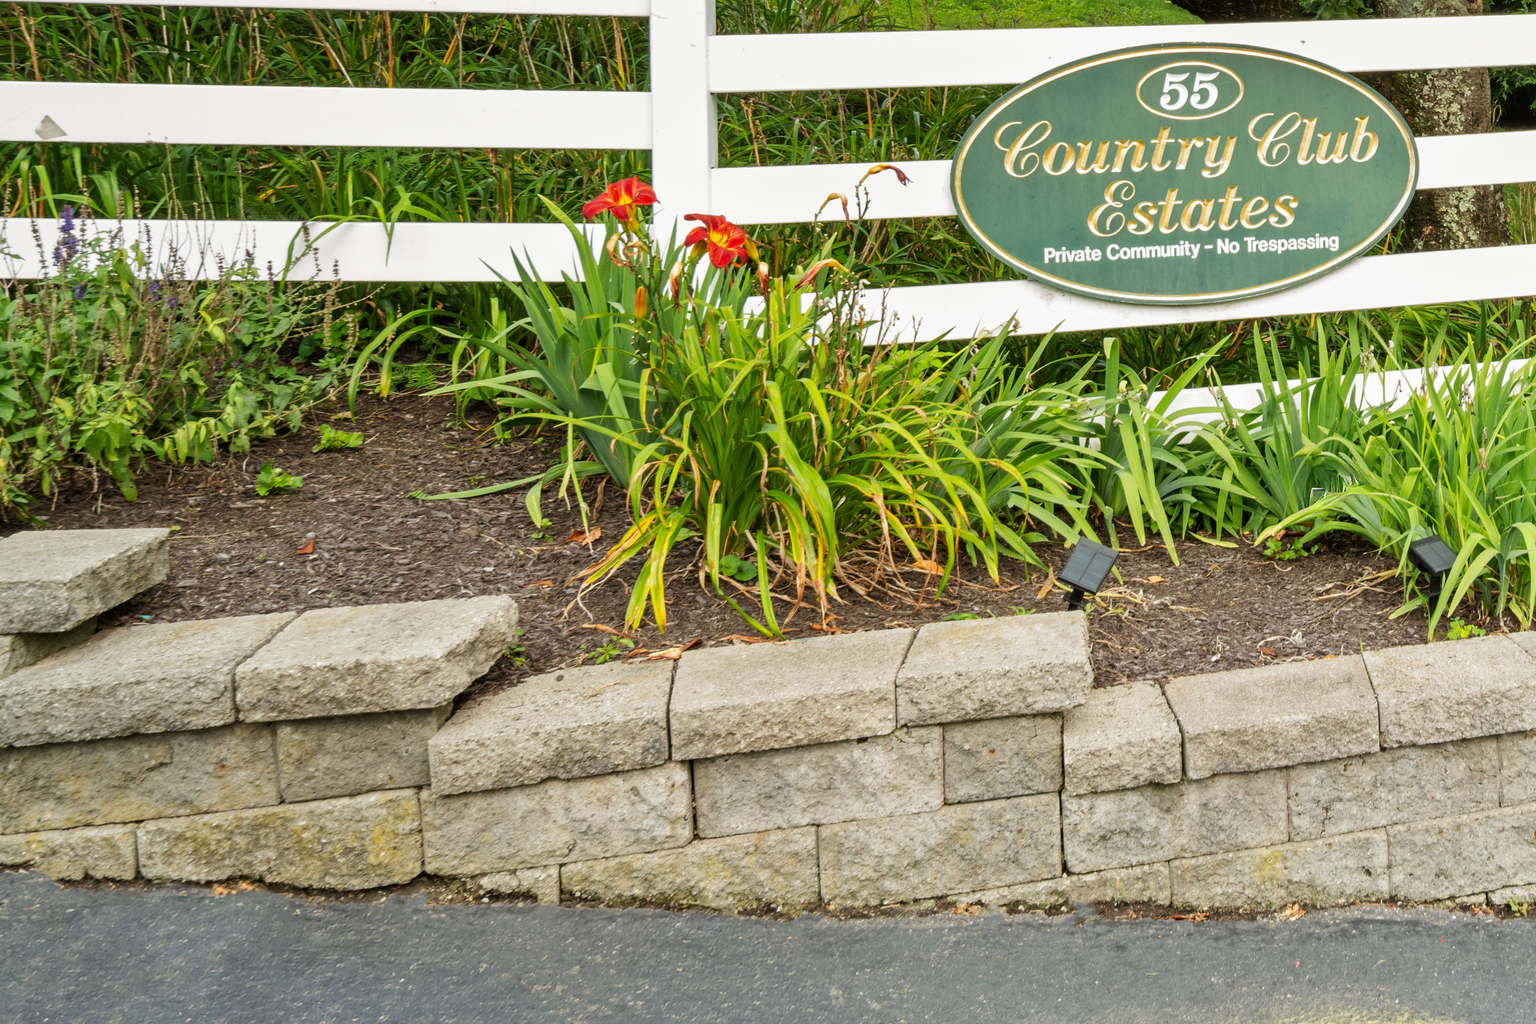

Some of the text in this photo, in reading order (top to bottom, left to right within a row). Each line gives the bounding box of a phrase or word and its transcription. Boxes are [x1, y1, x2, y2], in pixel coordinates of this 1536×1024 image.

[1159, 71, 1220, 110] 55
[994, 112, 1379, 178] Country Club
[1087, 179, 1299, 237] Estates
[1044, 246, 1102, 264] Private
[1106, 240, 1201, 261] Community
[1216, 238, 1240, 254] No
[1244, 233, 1340, 253] Trespassing
